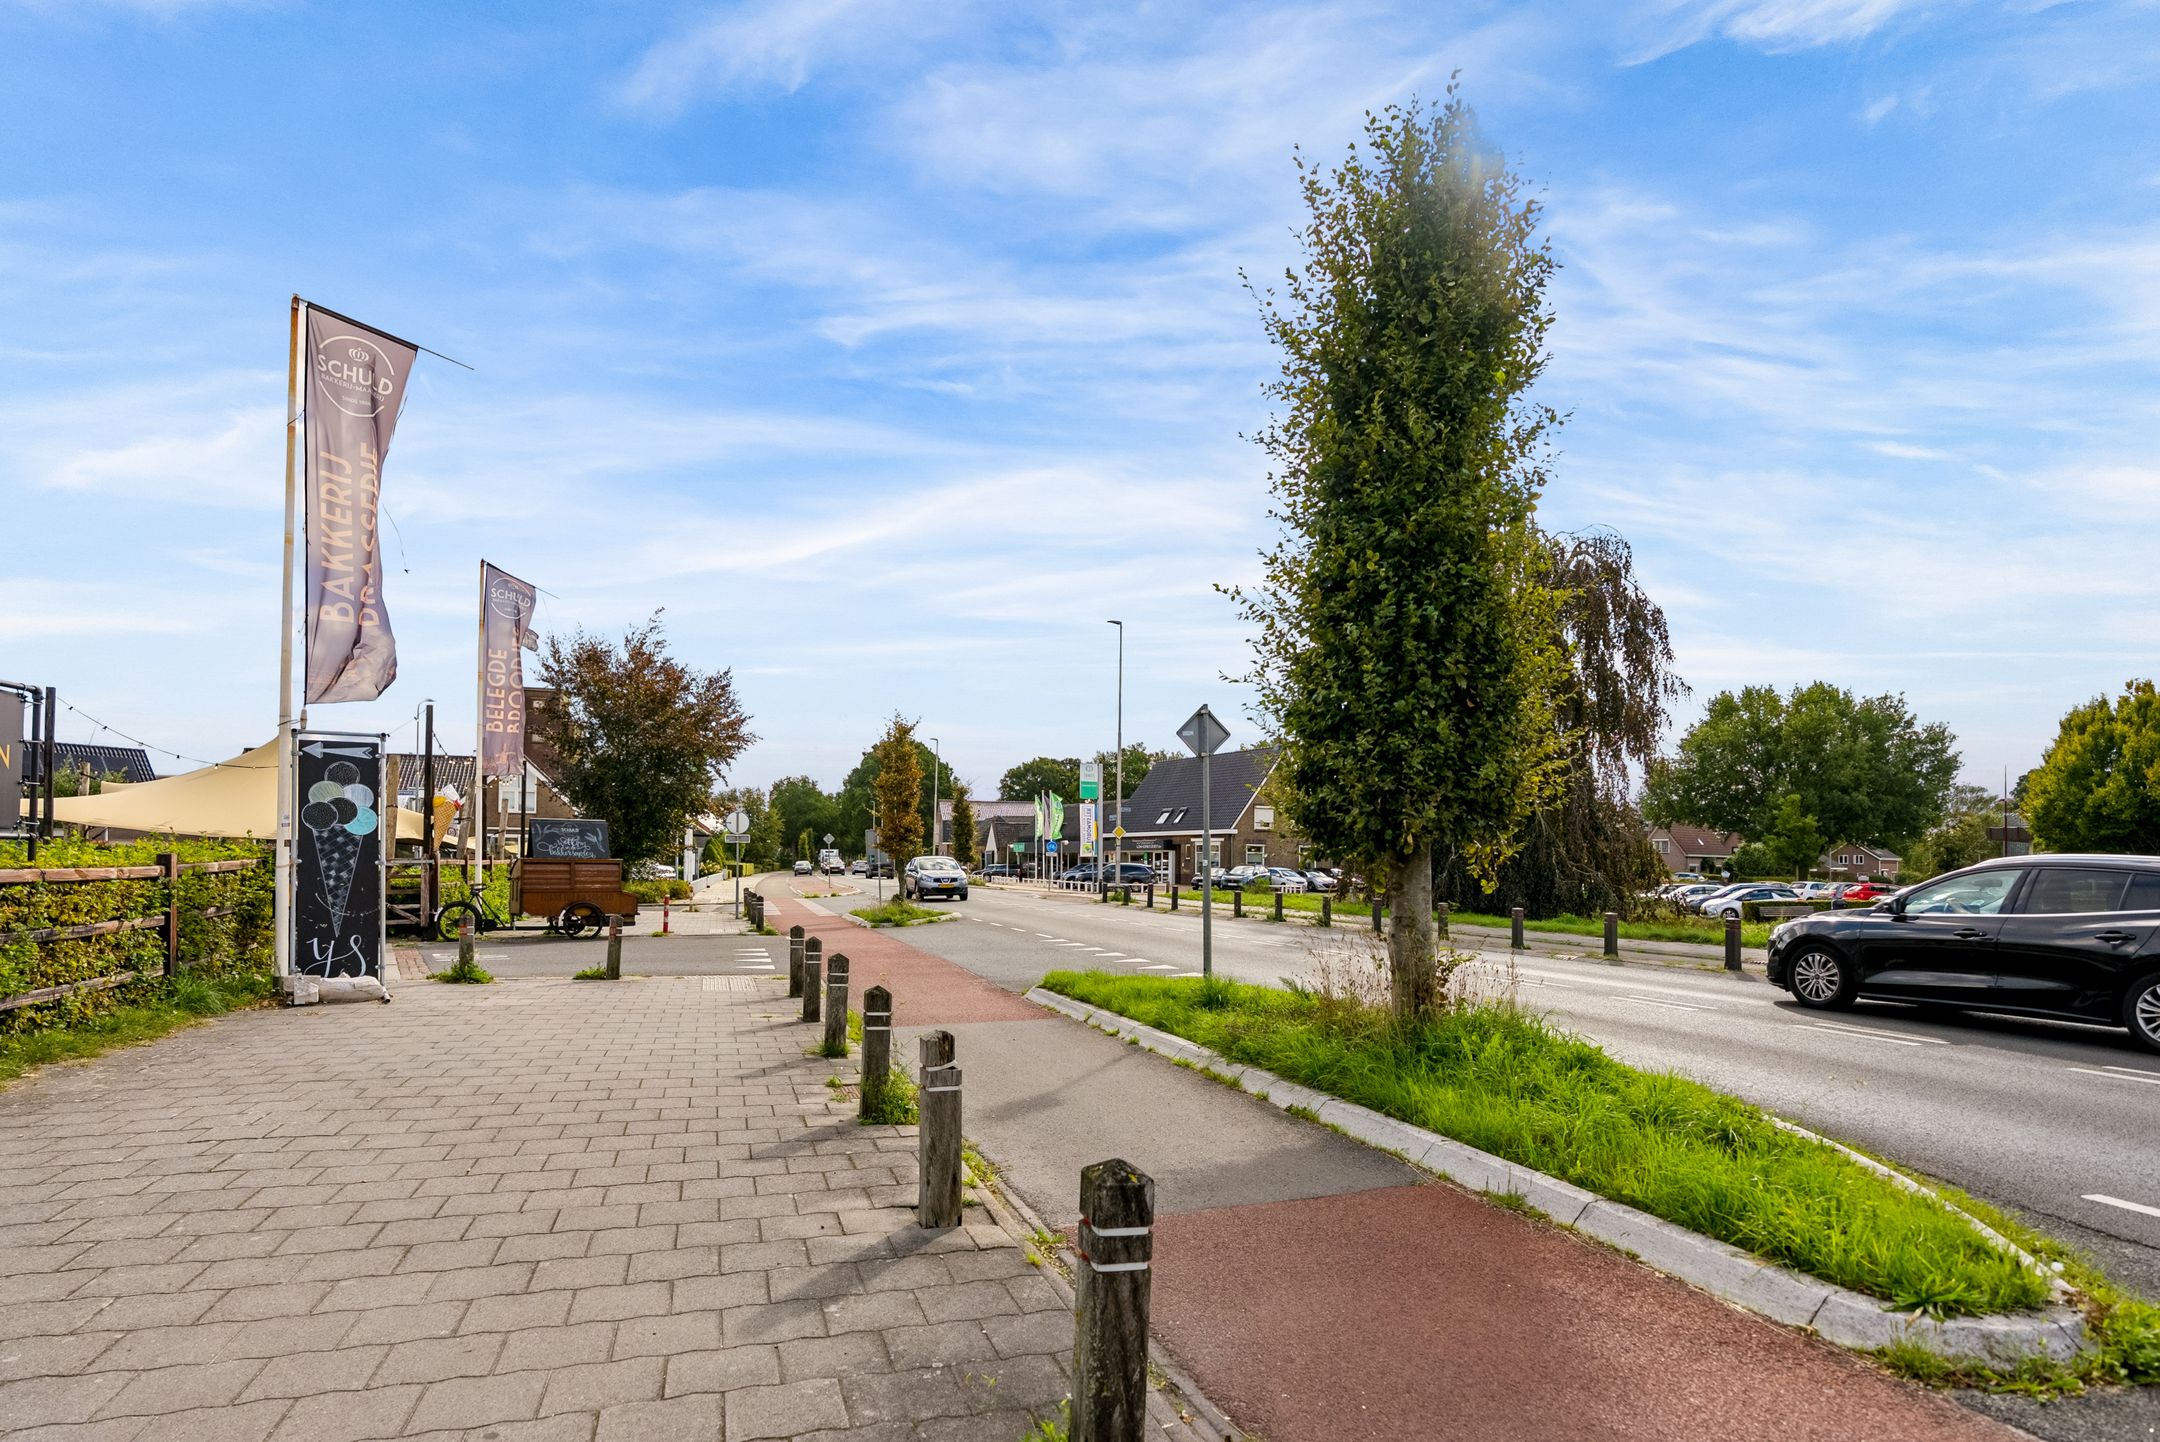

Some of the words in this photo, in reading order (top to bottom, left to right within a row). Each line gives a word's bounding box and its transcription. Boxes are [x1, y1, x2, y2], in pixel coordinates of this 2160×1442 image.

[318, 354, 393, 395] SCHULD
[320, 450, 354, 624] BAKKERIJ
[490, 587, 531, 607] SCHULD
[485, 648, 508, 733] BELEGDE
